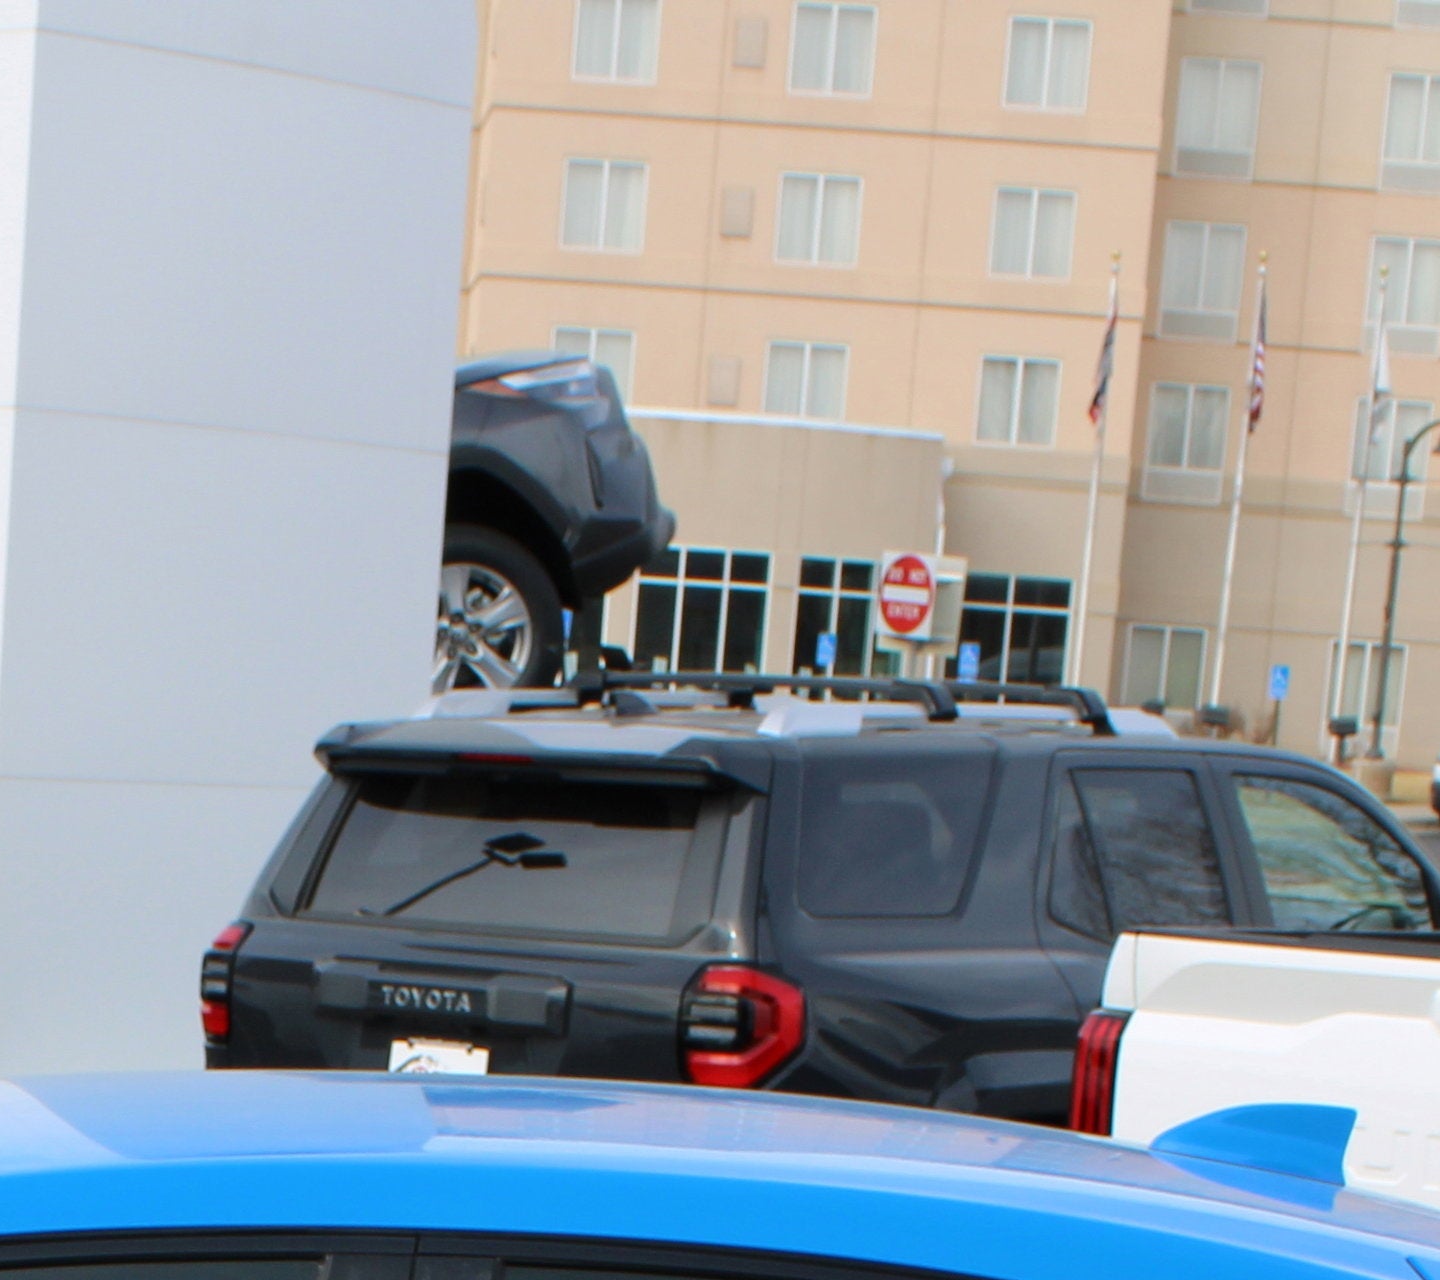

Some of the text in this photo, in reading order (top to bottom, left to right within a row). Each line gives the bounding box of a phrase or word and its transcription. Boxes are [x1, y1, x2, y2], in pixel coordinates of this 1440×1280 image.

[908, 568, 927, 585] NOT
[886, 601, 921, 620] ENTER
[381, 984, 472, 1013] TOYOTA
